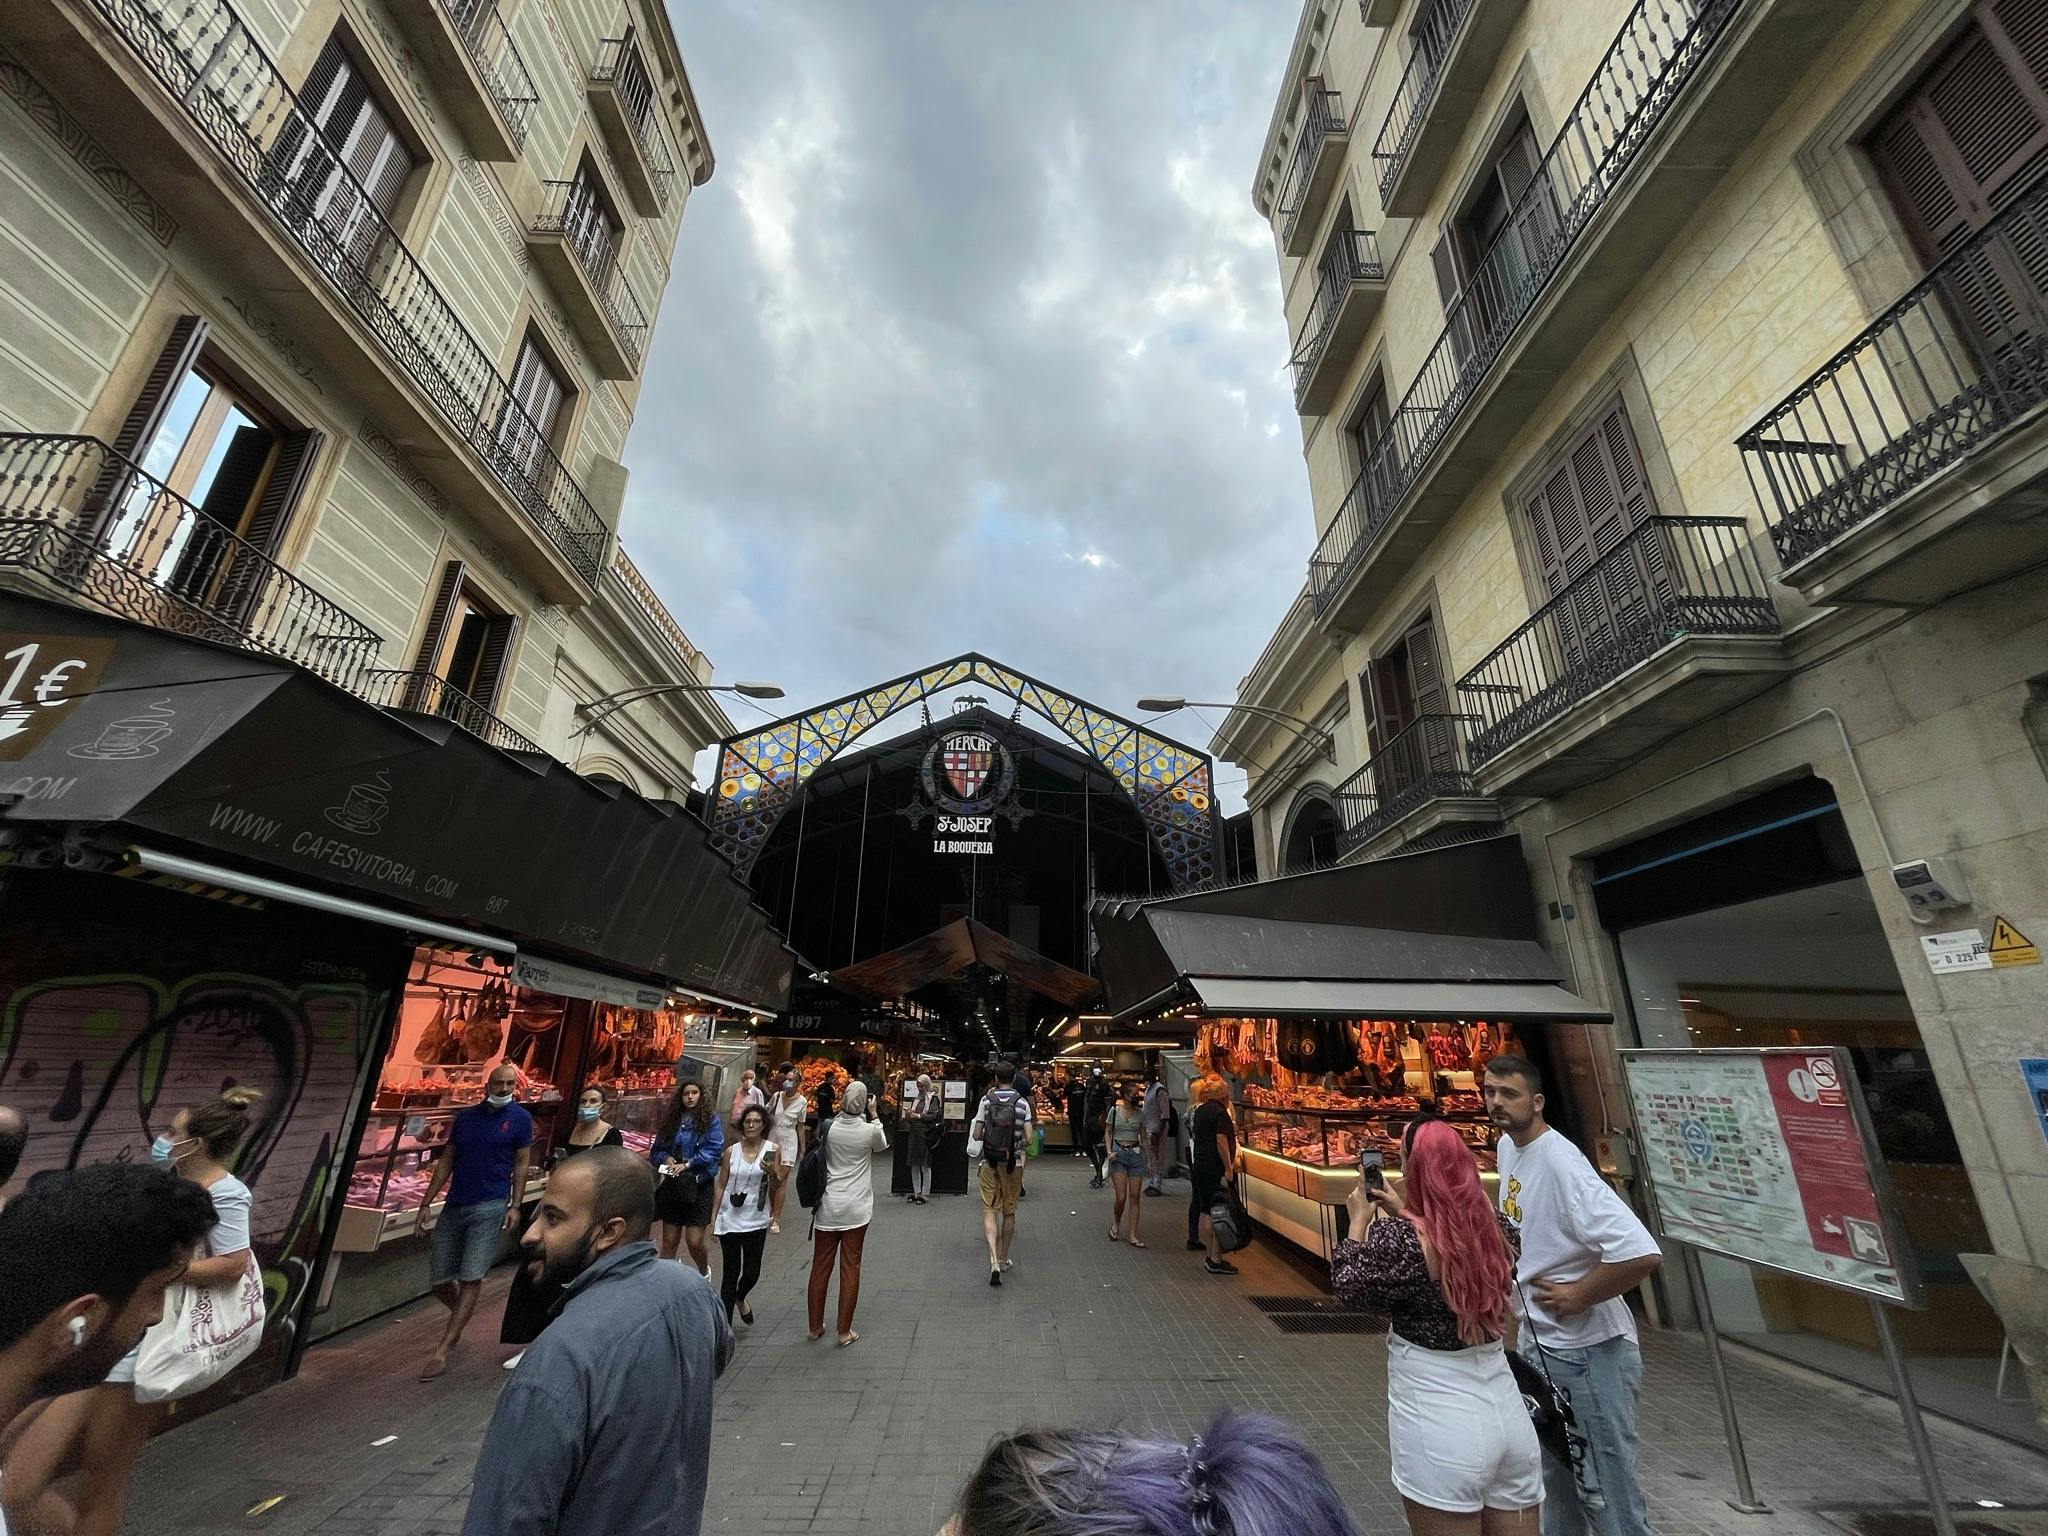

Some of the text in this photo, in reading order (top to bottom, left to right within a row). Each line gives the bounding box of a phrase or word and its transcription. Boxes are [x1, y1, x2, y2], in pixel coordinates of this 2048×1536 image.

[945, 735, 993, 752] MERCAT
[933, 840, 994, 854] LA BOQUERIA
[788, 1015, 822, 1029] 1897
